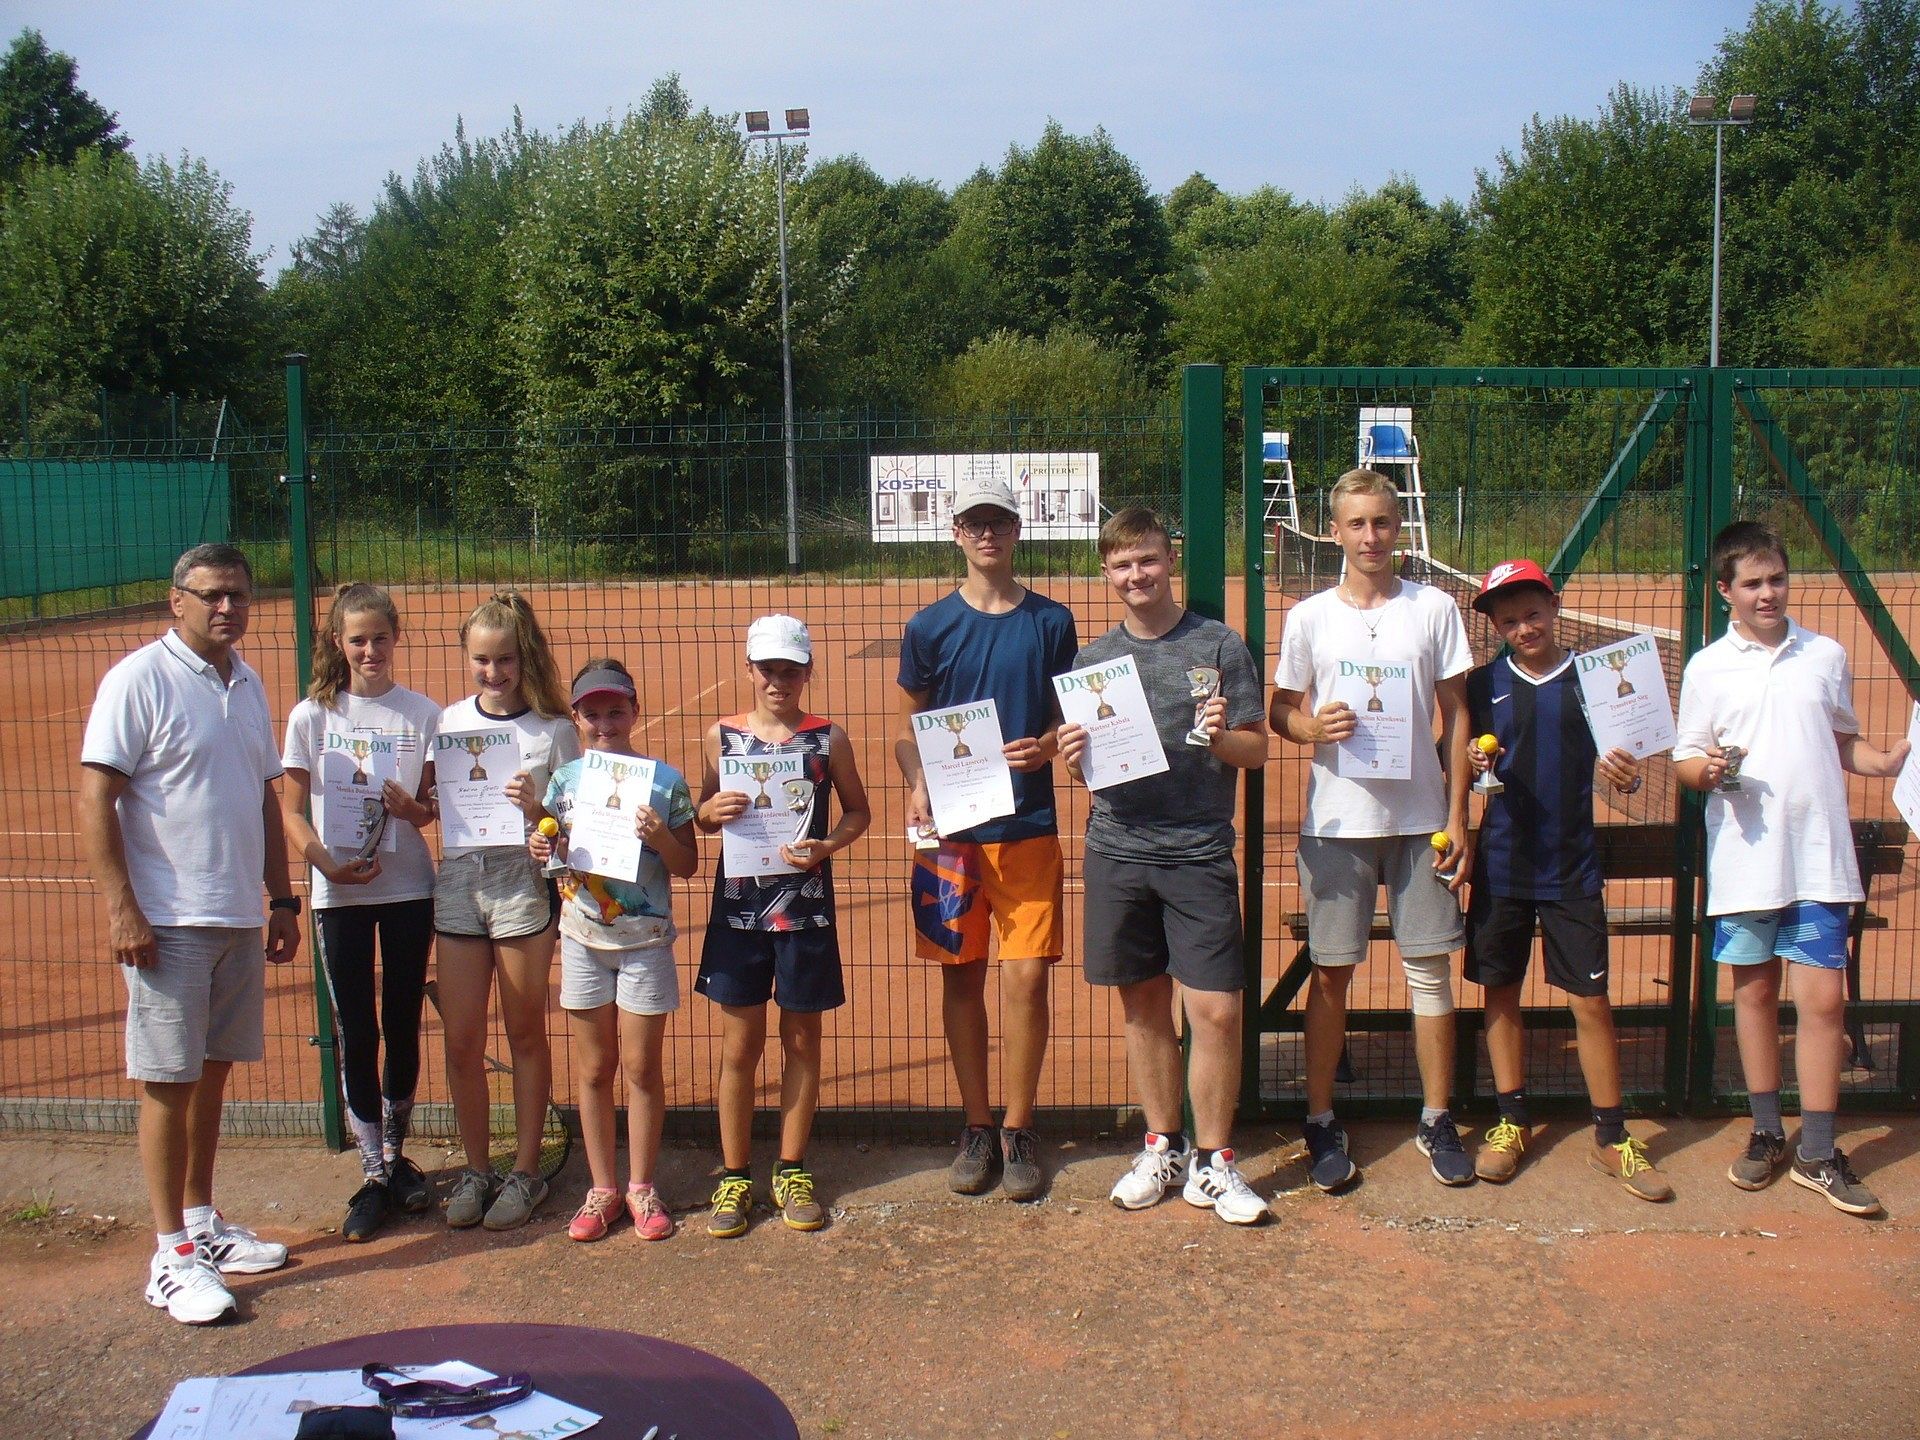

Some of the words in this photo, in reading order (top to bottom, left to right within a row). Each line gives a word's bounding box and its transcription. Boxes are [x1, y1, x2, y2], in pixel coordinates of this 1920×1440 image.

[878, 479, 947, 490] KOSPEL
[1581, 640, 1651, 674] DYPLOM
[1058, 663, 1131, 694] DYPLOM
[1339, 660, 1407, 680] DYPLOM
[916, 706, 991, 732] DYPLOM
[328, 733, 392, 753] DYPLOM
[437, 732, 511, 750] DYPLOM
[588, 752, 650, 779] DYPLOM
[724, 759, 797, 776] DYPLOM
